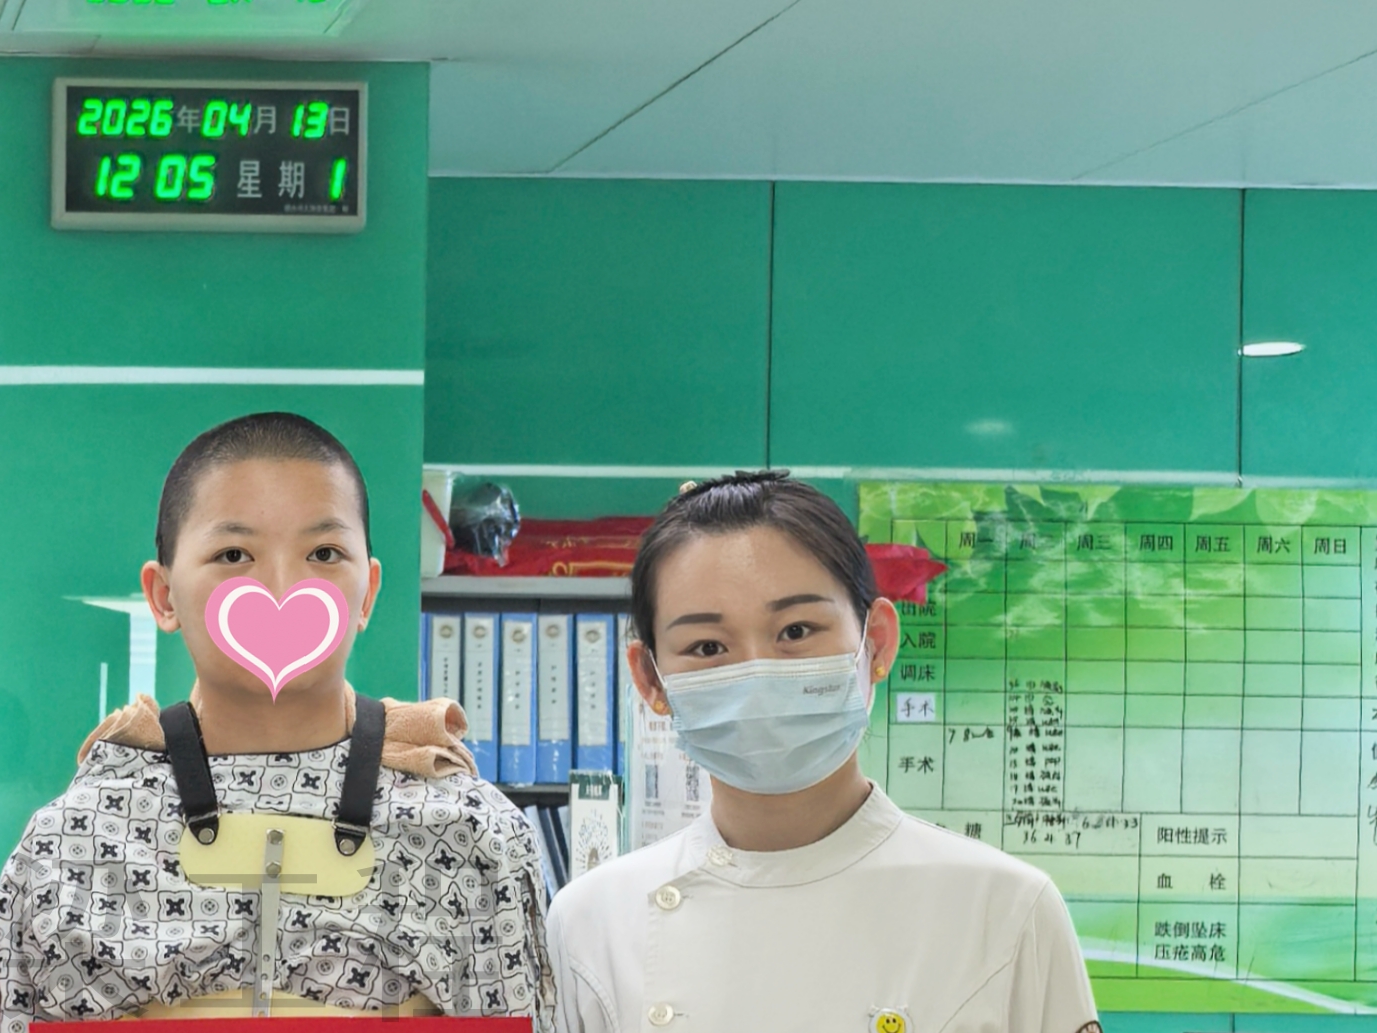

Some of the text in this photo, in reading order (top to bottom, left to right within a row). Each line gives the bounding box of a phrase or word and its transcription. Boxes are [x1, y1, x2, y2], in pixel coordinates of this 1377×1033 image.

[959, 531, 994, 549] 周一
[1076, 533, 1111, 551] 周三
[1140, 533, 1173, 552] 周四
[1195, 535, 1231, 553] 周五
[1257, 536, 1291, 554] 周六
[1313, 537, 1347, 555] 周日
[900, 632, 937, 650] 入院
[900, 664, 936, 682] 调床
[898, 756, 934, 774] 手术
[1156, 826, 1228, 845] 阳性提示
[1154, 920, 1227, 939] 跌倒坠床
[1154, 943, 1226, 962] 压疮高危
